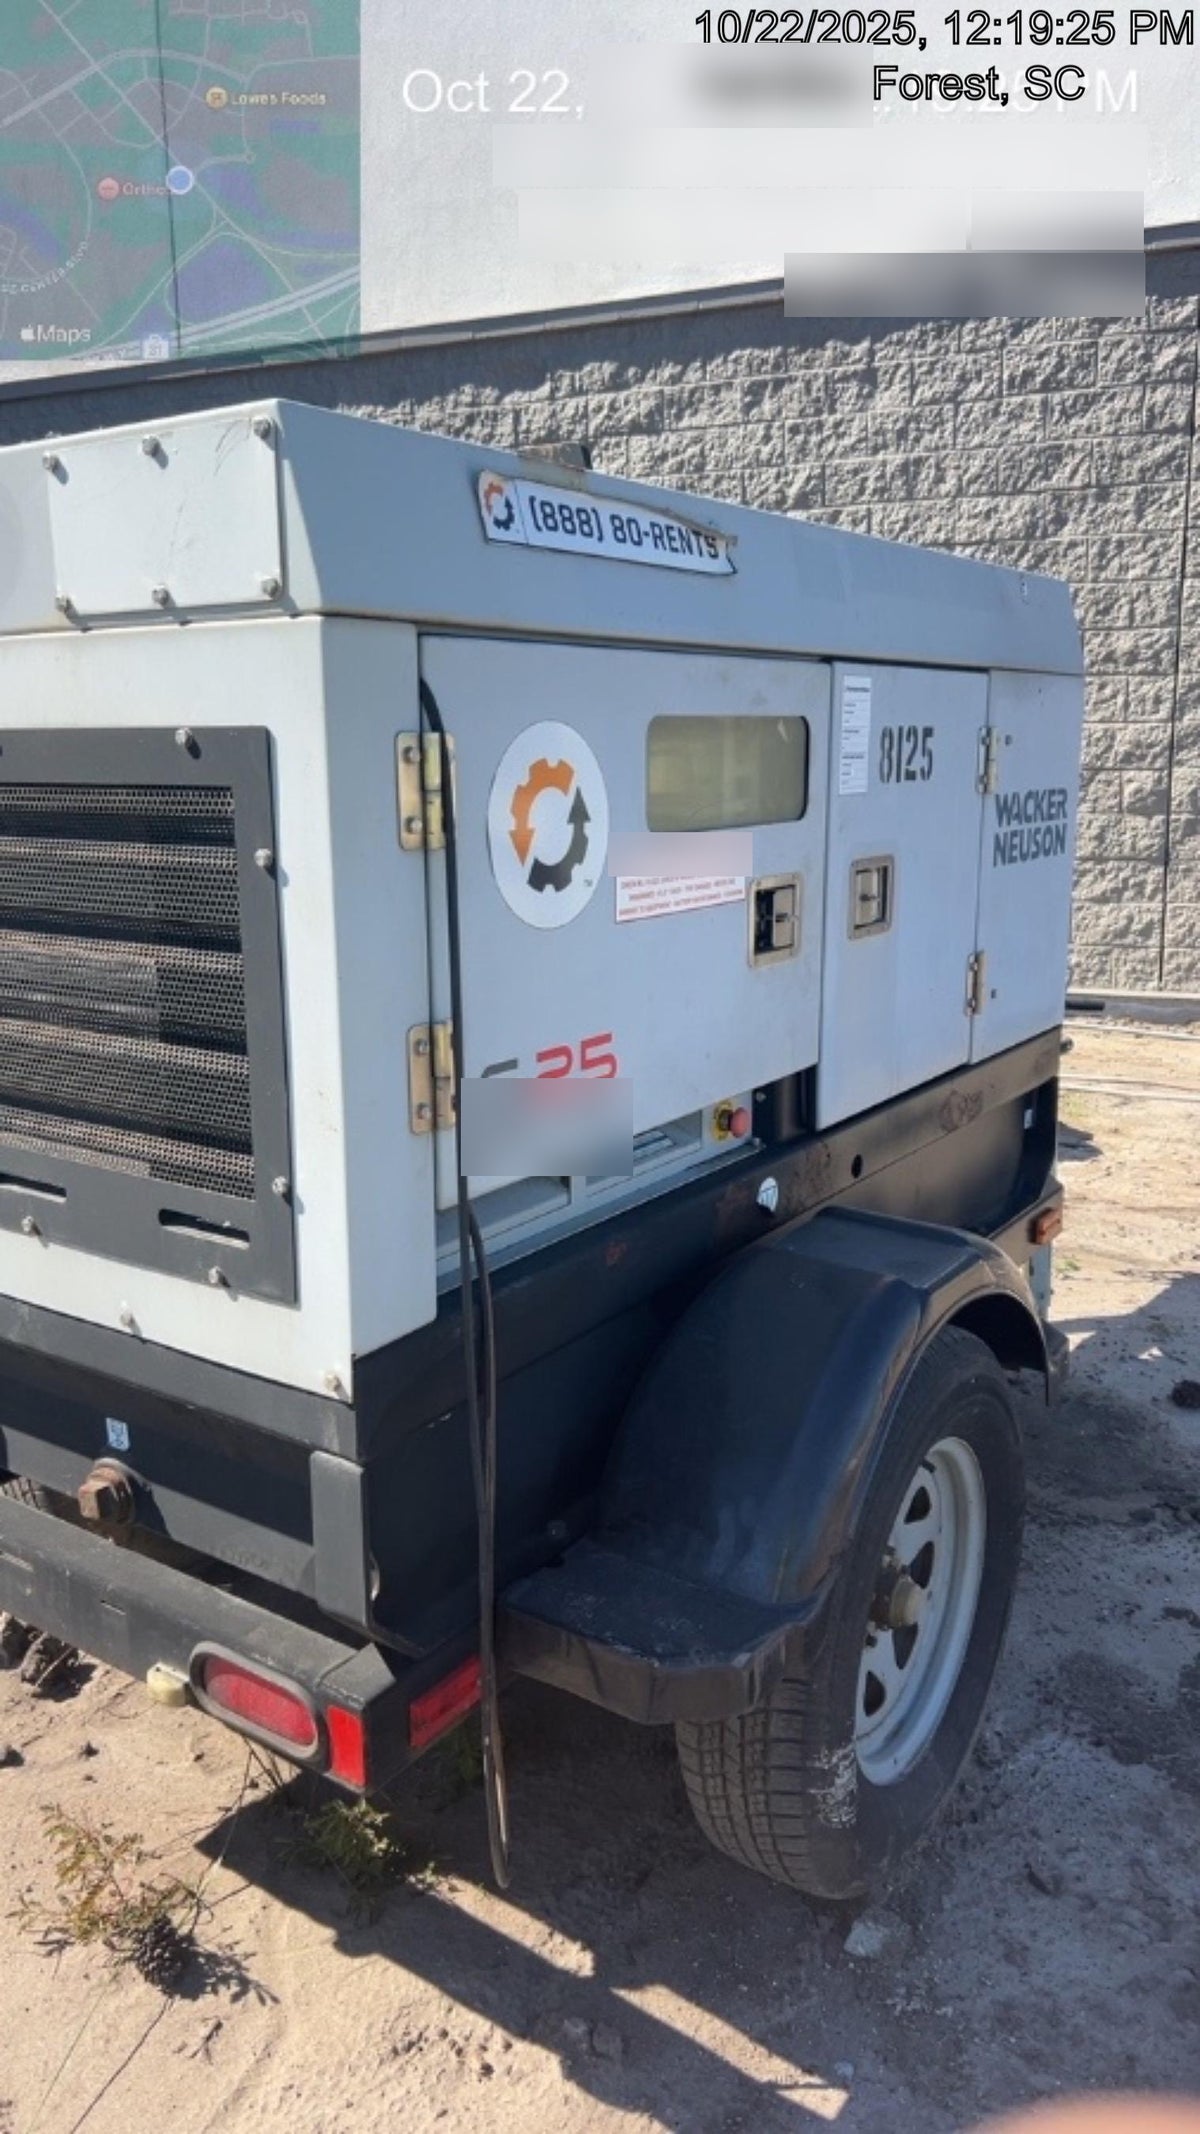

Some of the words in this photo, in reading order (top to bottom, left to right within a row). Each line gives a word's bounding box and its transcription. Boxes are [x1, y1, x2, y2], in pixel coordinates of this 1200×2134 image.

[529, 495, 604, 542] (888)
[609, 513, 719, 560] 80-RENTS
[879, 725, 935, 784] 8125
[995, 788, 1068, 828] WACKER
[992, 822, 1068, 868] NEUSON
